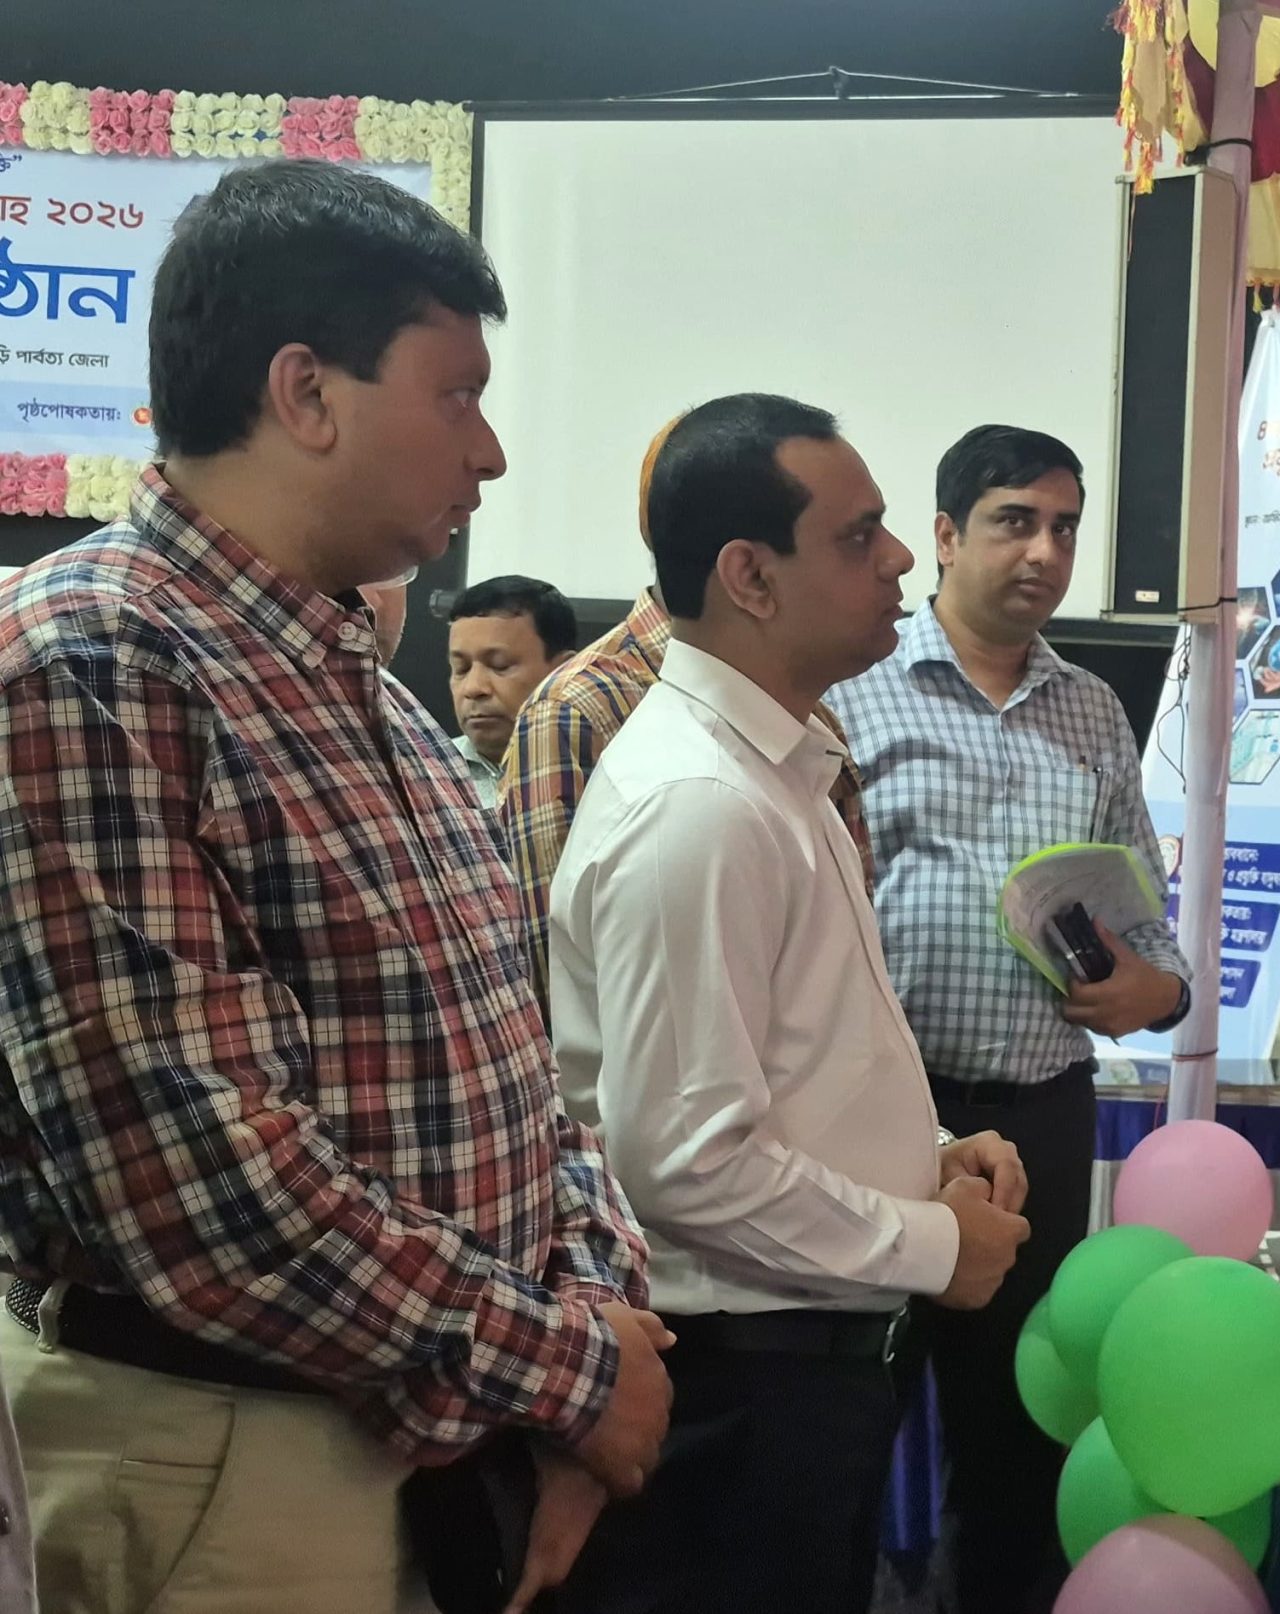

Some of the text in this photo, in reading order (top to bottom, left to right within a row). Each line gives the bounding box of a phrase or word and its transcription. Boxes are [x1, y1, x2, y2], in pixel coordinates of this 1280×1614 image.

[47, 198, 144, 229] ২০২৬
[16, 347, 64, 366] পার্বত্য
[69, 353, 110, 368] জেলা
